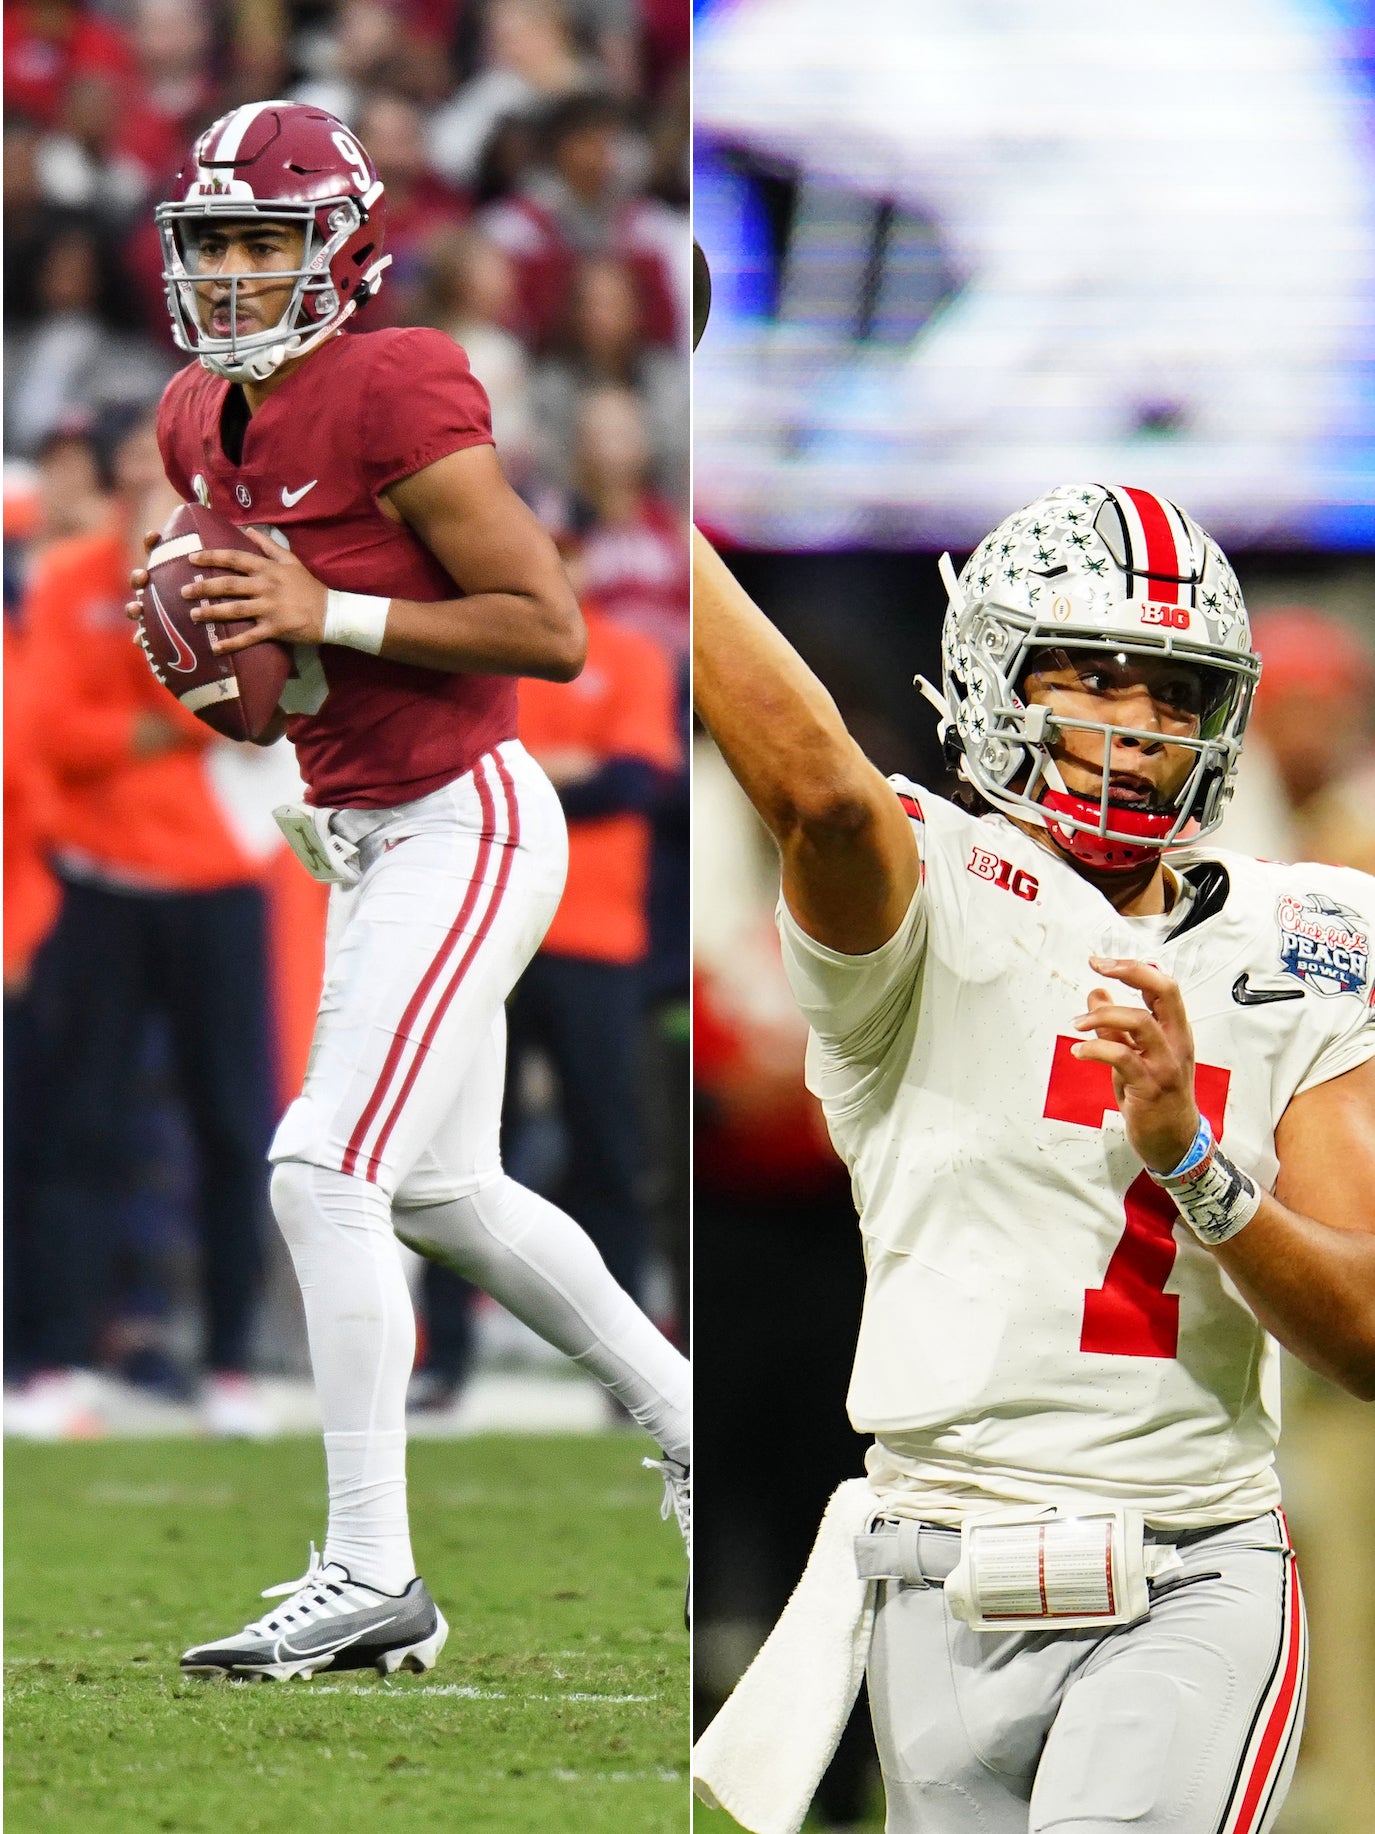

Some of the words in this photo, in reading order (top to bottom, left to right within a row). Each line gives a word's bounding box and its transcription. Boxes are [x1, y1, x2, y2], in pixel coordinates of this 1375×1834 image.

[331, 130, 371, 193] 9
[199, 183, 232, 195] BAMA
[1281, 930, 1367, 981] PEACH
[1296, 959, 1351, 984] BOWL
[1042, 1035, 1232, 1359] 7
